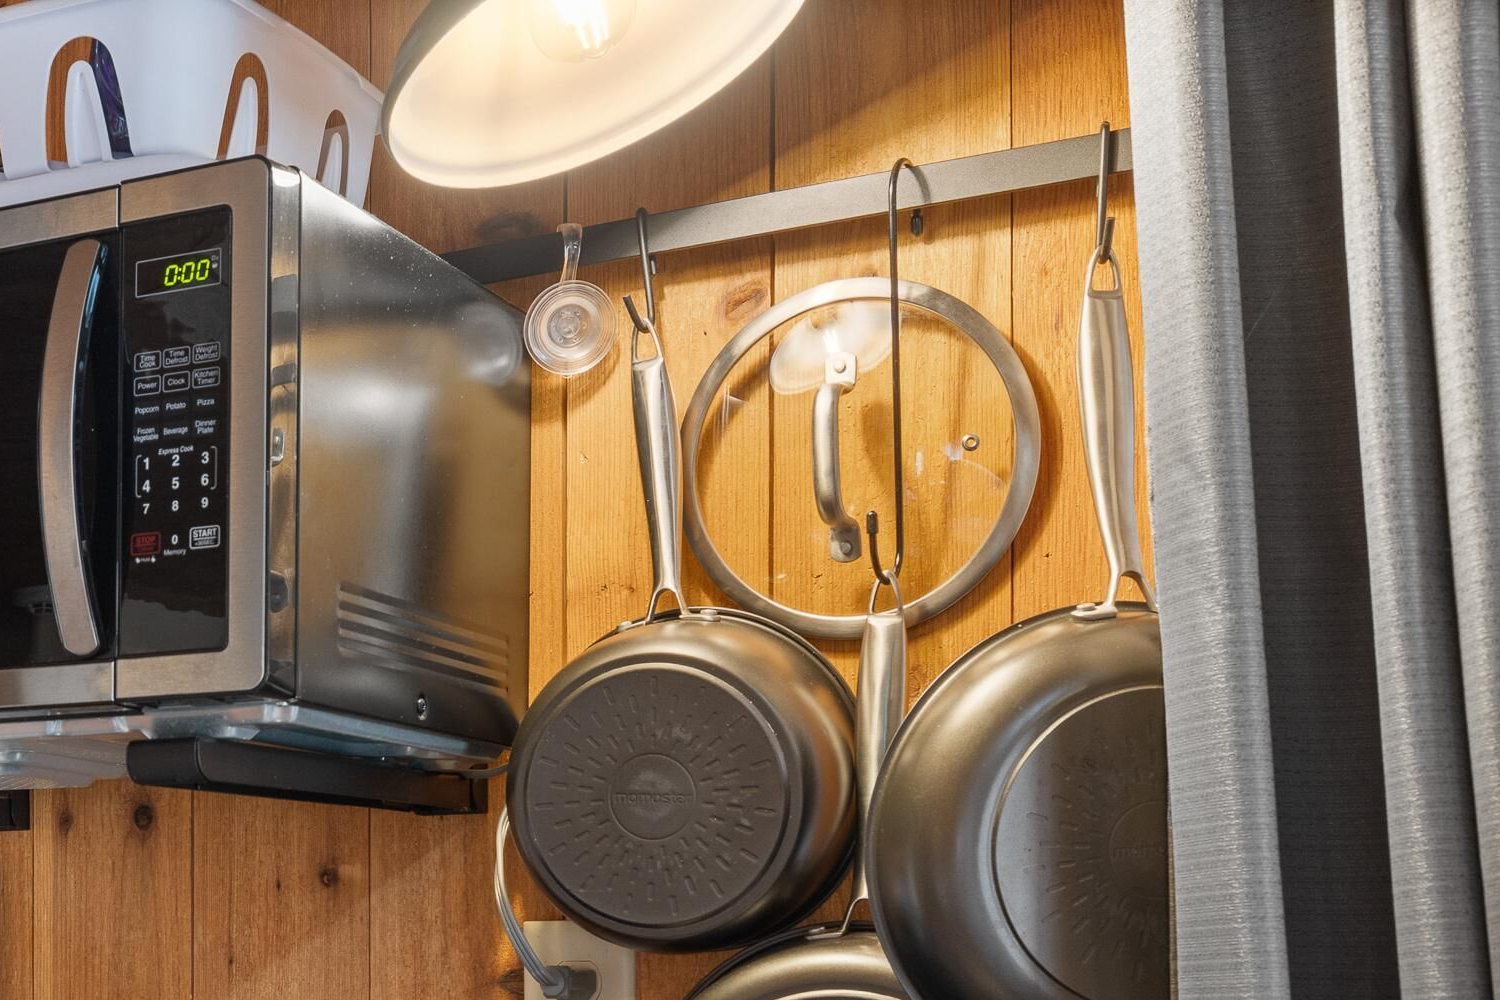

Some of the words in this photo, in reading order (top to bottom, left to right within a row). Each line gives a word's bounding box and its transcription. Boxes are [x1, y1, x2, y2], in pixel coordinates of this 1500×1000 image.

[164, 259, 211, 286] 0:00
[169, 350, 185, 358] Time
[195, 343, 218, 355] Weight
[140, 354, 156, 362] Time
[165, 355, 188, 366] Defrost
[195, 351, 218, 361] Defrost
[140, 360, 156, 368] Cook
[194, 369, 219, 379] Kitchen
[137, 380, 157, 391] Power
[167, 376, 186, 386] Clock
[197, 376, 216, 385] Timer
[166, 400, 186, 411] Potato
[197, 397, 215, 407] Pizza
[134, 404, 160, 415] Popcorn
[195, 418, 216, 429] Dinner
[137, 426, 156, 436] Frozen
[196, 424, 214, 435] Plate
[133, 431, 159, 443] Vegetable
[158, 446, 178, 457] Express
[179, 444, 194, 453] Cook
[143, 458, 150, 470] 1
[172, 455, 180, 467] 2
[201, 452, 210, 465] 3
[142, 479, 151, 493] 4
[172, 477, 180, 490] 5
[201, 473, 209, 487] 6
[142, 503, 150, 515] 7
[172, 500, 179, 512] 8
[201, 497, 209, 509] 9
[171, 534, 178, 546] 0
[193, 528, 218, 540] START
[163, 547, 186, 557] Memory
